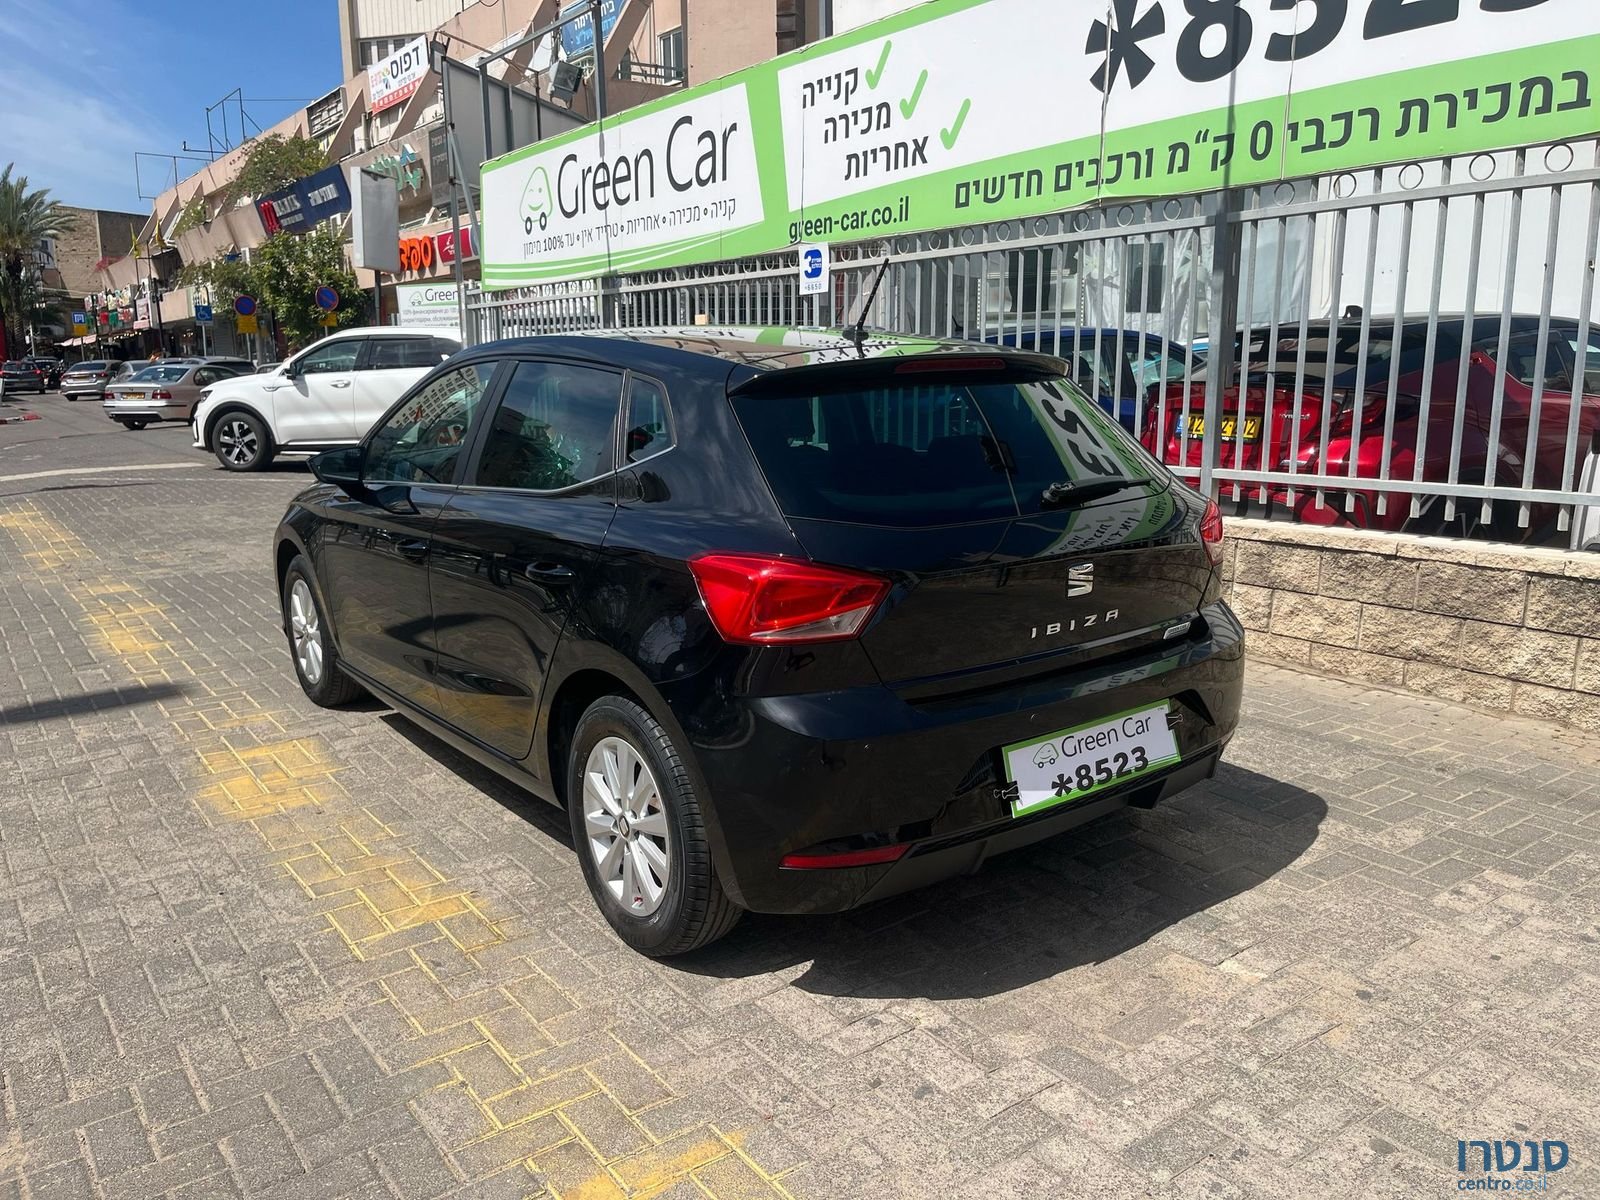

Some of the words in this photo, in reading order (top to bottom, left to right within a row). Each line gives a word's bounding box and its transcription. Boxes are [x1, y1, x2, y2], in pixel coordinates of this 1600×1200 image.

[390, 46, 419, 79] דפוס
[802, 67, 859, 109] קנייה
[1394, 69, 1591, 137] במכירת
[824, 101, 891, 144] מכירה
[1249, 119, 1273, 162] 0
[1287, 107, 1381, 154] רכבי
[557, 148, 655, 218] Green
[666, 115, 738, 192] Car
[845, 136, 929, 181] אחריות
[1054, 147, 1154, 193] ורכבים
[711, 198, 736, 220] קניה
[954, 169, 1043, 209] חדשים
[626, 213, 661, 235] אחריות
[669, 205, 701, 227] מכירה
[789, 196, 909, 244] green-car.co.il
[523, 240, 541, 260] מימון
[543, 236, 564, 251] 100%
[566, 234, 575, 247] עד
[424, 288, 458, 302] Green
[1030, 608, 1119, 639] IBIZA
[1061, 727, 1119, 758] Green
[1121, 716, 1151, 738] Car
